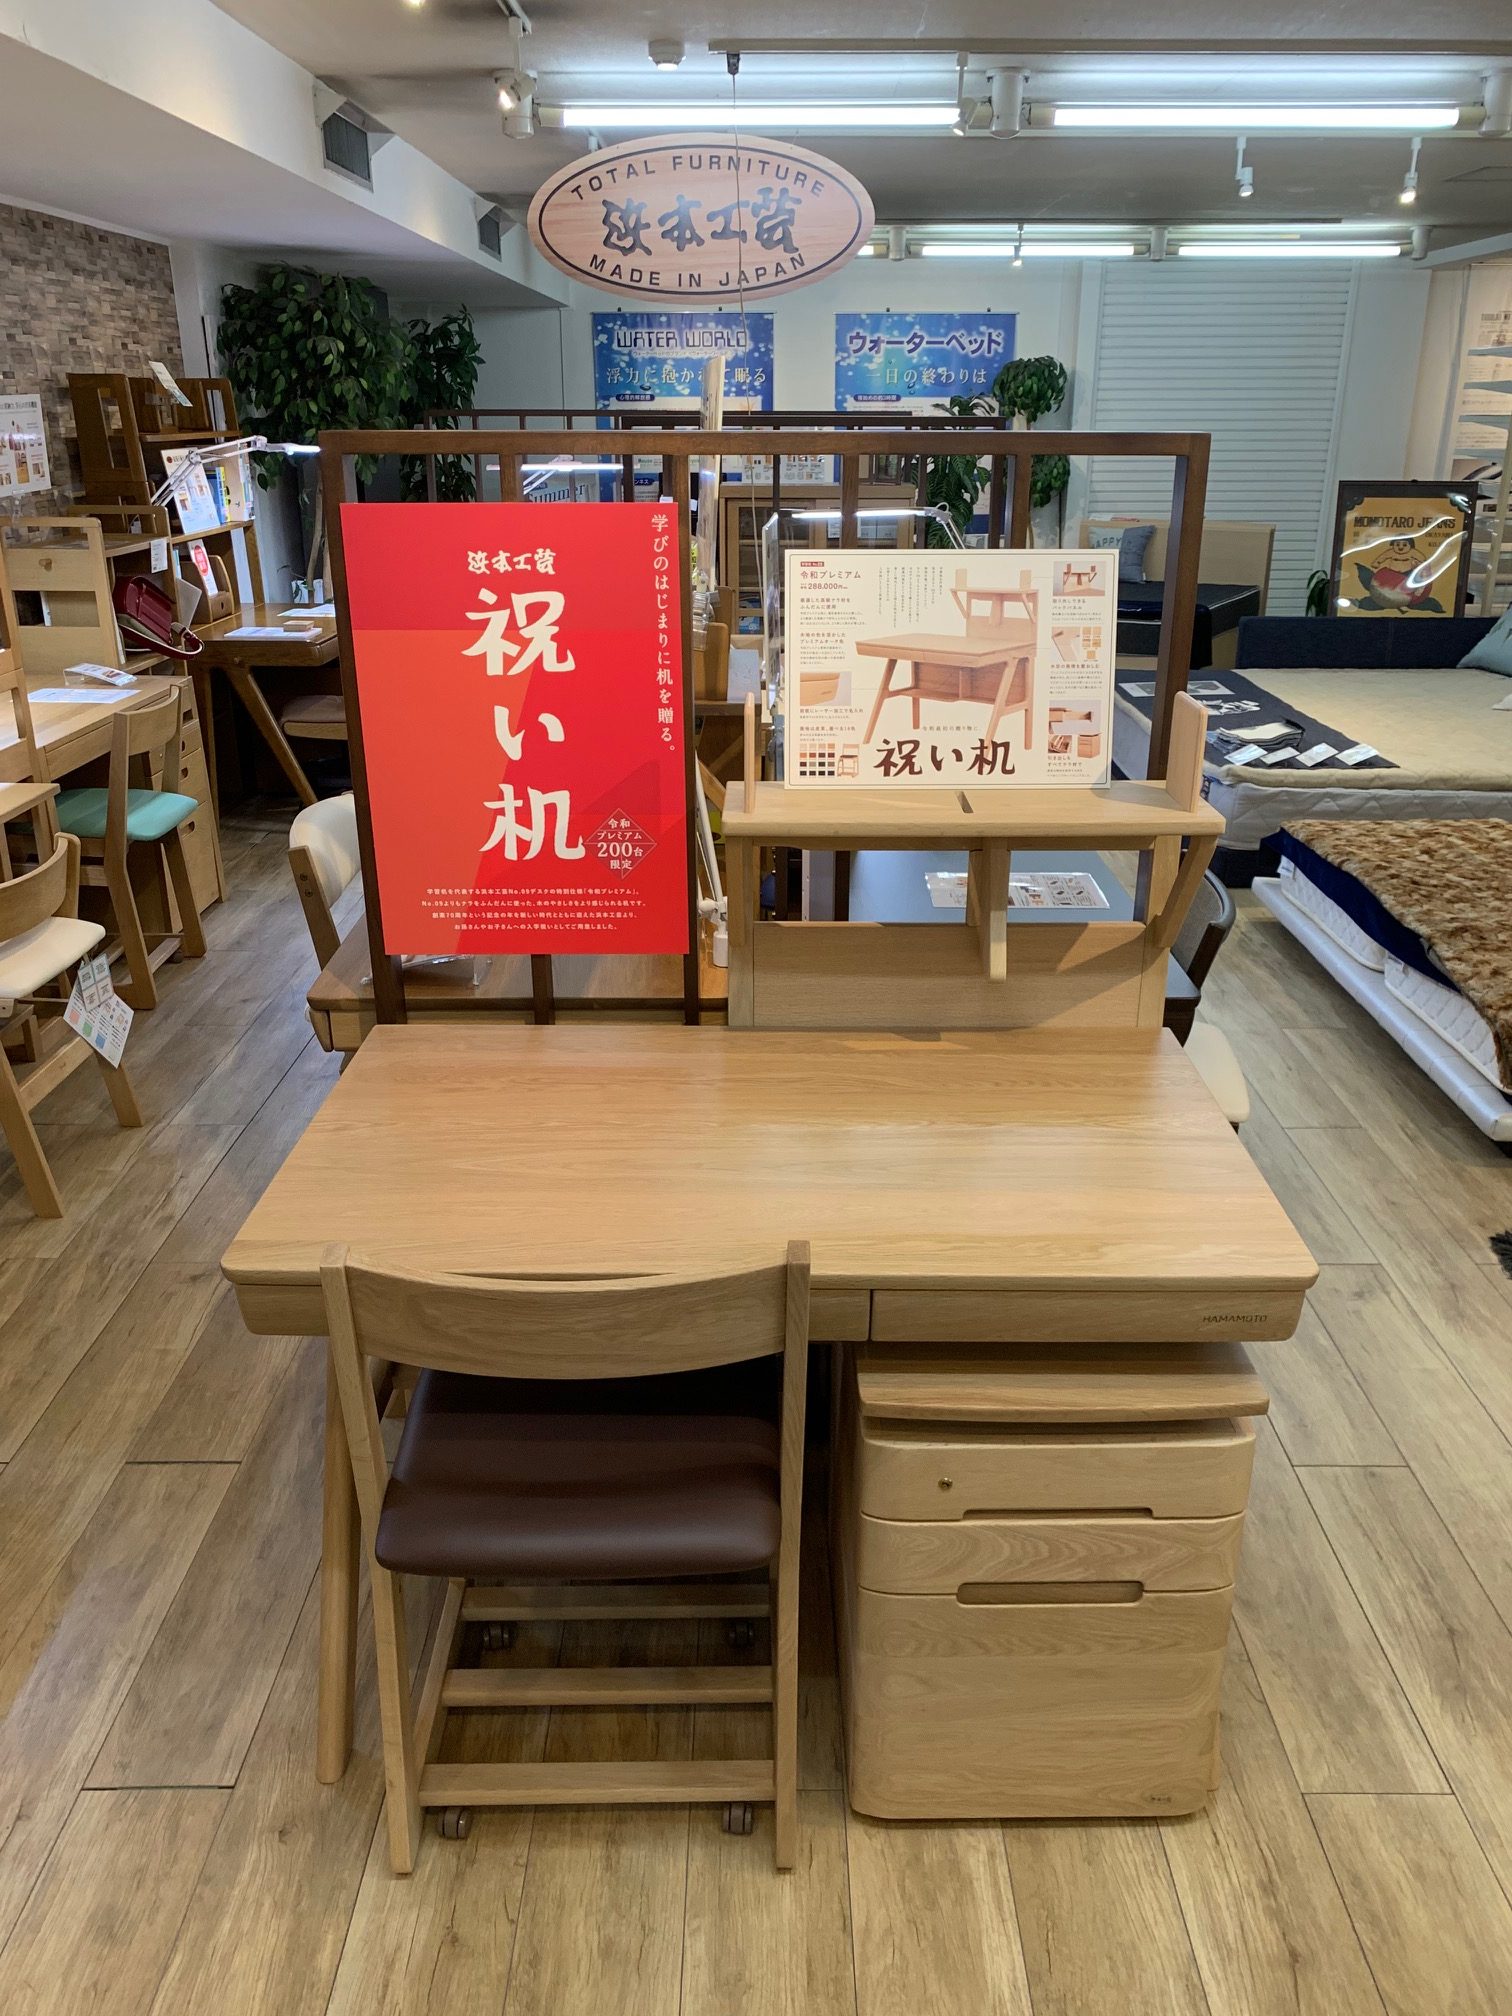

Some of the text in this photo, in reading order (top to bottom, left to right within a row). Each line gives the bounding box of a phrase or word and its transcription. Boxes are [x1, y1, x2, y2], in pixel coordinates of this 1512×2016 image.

[570, 154, 825, 202] TOTAL FURNITURE
[602, 187, 803, 256] 浜本工芸
[589, 253, 807, 288] MADE IN JAPAN
[616, 331, 747, 348] WATER WORLD
[849, 332, 1002, 354] ウォーターベッド
[607, 367, 767, 384] 浮力に抱かて眠る
[866, 368, 986, 384] 一日の終わりは
[526, 483, 585, 502] Summr
[467, 549, 556, 574] 浜本工芸
[800, 571, 861, 579] 令和プレミアム
[651, 514, 675, 751] 学びのはじまりに机を贈る。
[460, 588, 586, 861] 祝い机
[873, 738, 1015, 777] 祝い机
[608, 818, 630, 829] 令和
[597, 831, 642, 840] プレミアム
[597, 841, 643, 857] 200台
[610, 859, 632, 870] 限定
